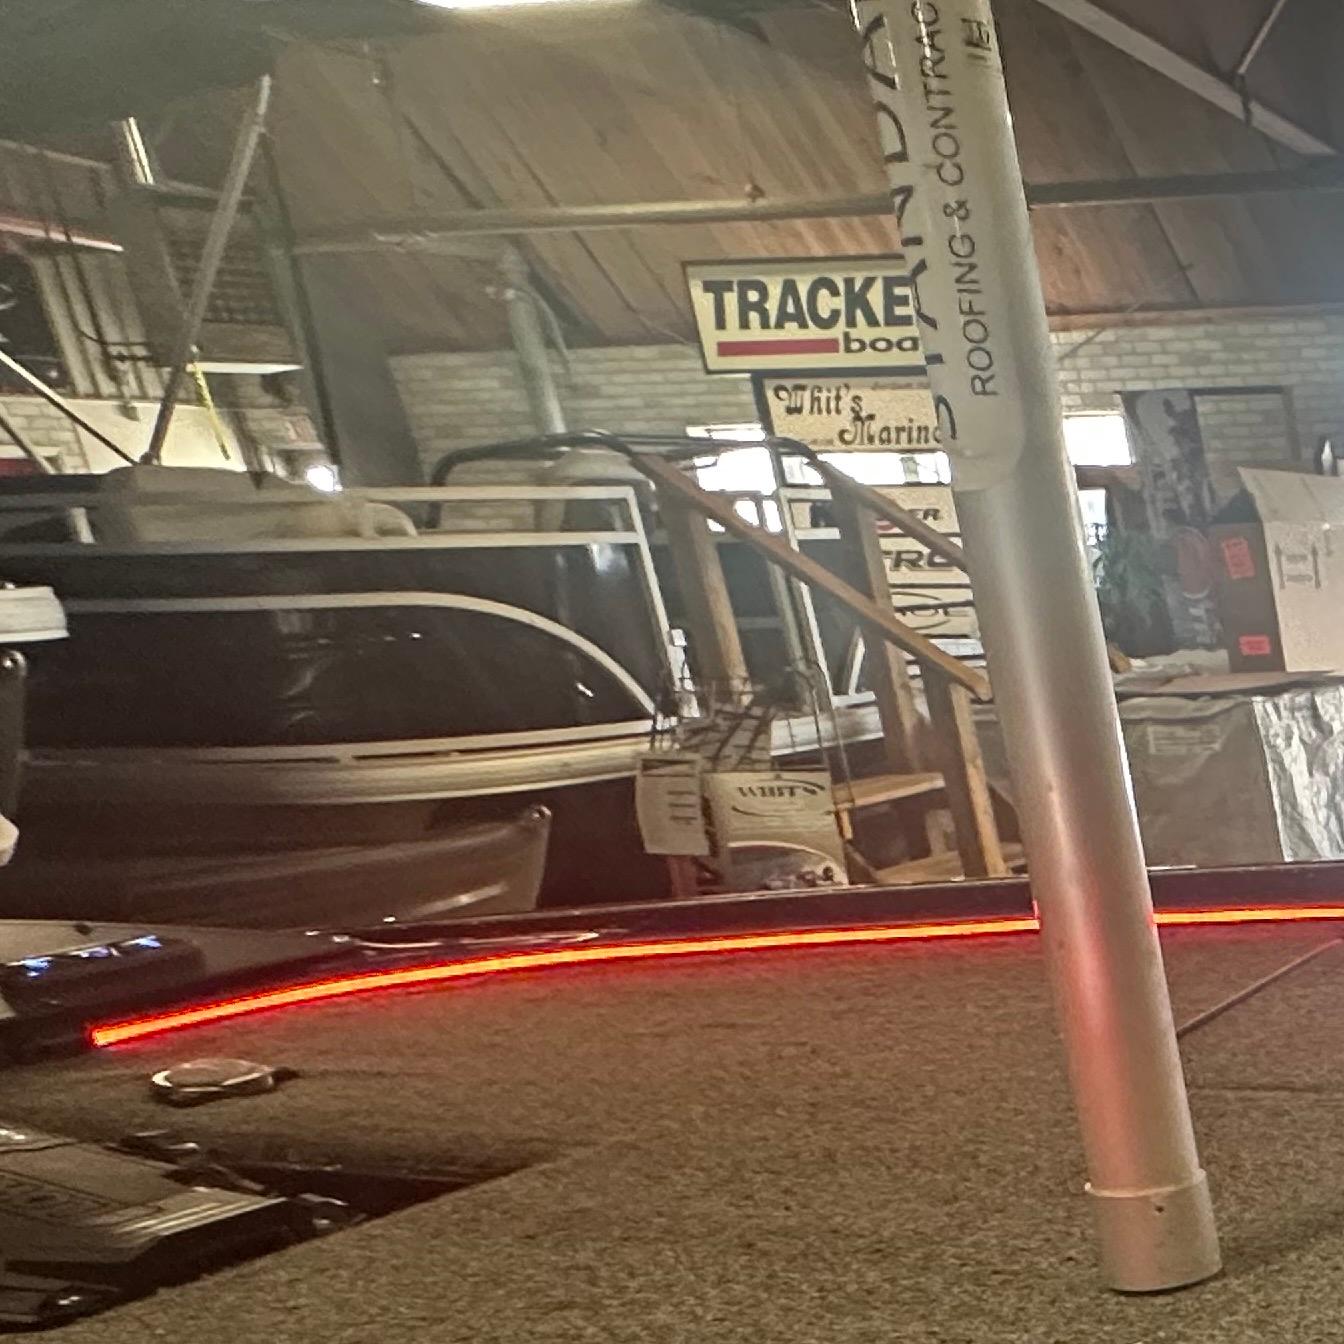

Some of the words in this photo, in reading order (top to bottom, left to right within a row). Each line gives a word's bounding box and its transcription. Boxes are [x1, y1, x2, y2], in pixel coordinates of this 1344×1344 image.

[943, 200, 970, 221] &
[702, 277, 913, 330] TRACKE
[948, 234, 998, 396] ROOFING
[773, 383, 863, 415] Whit's
